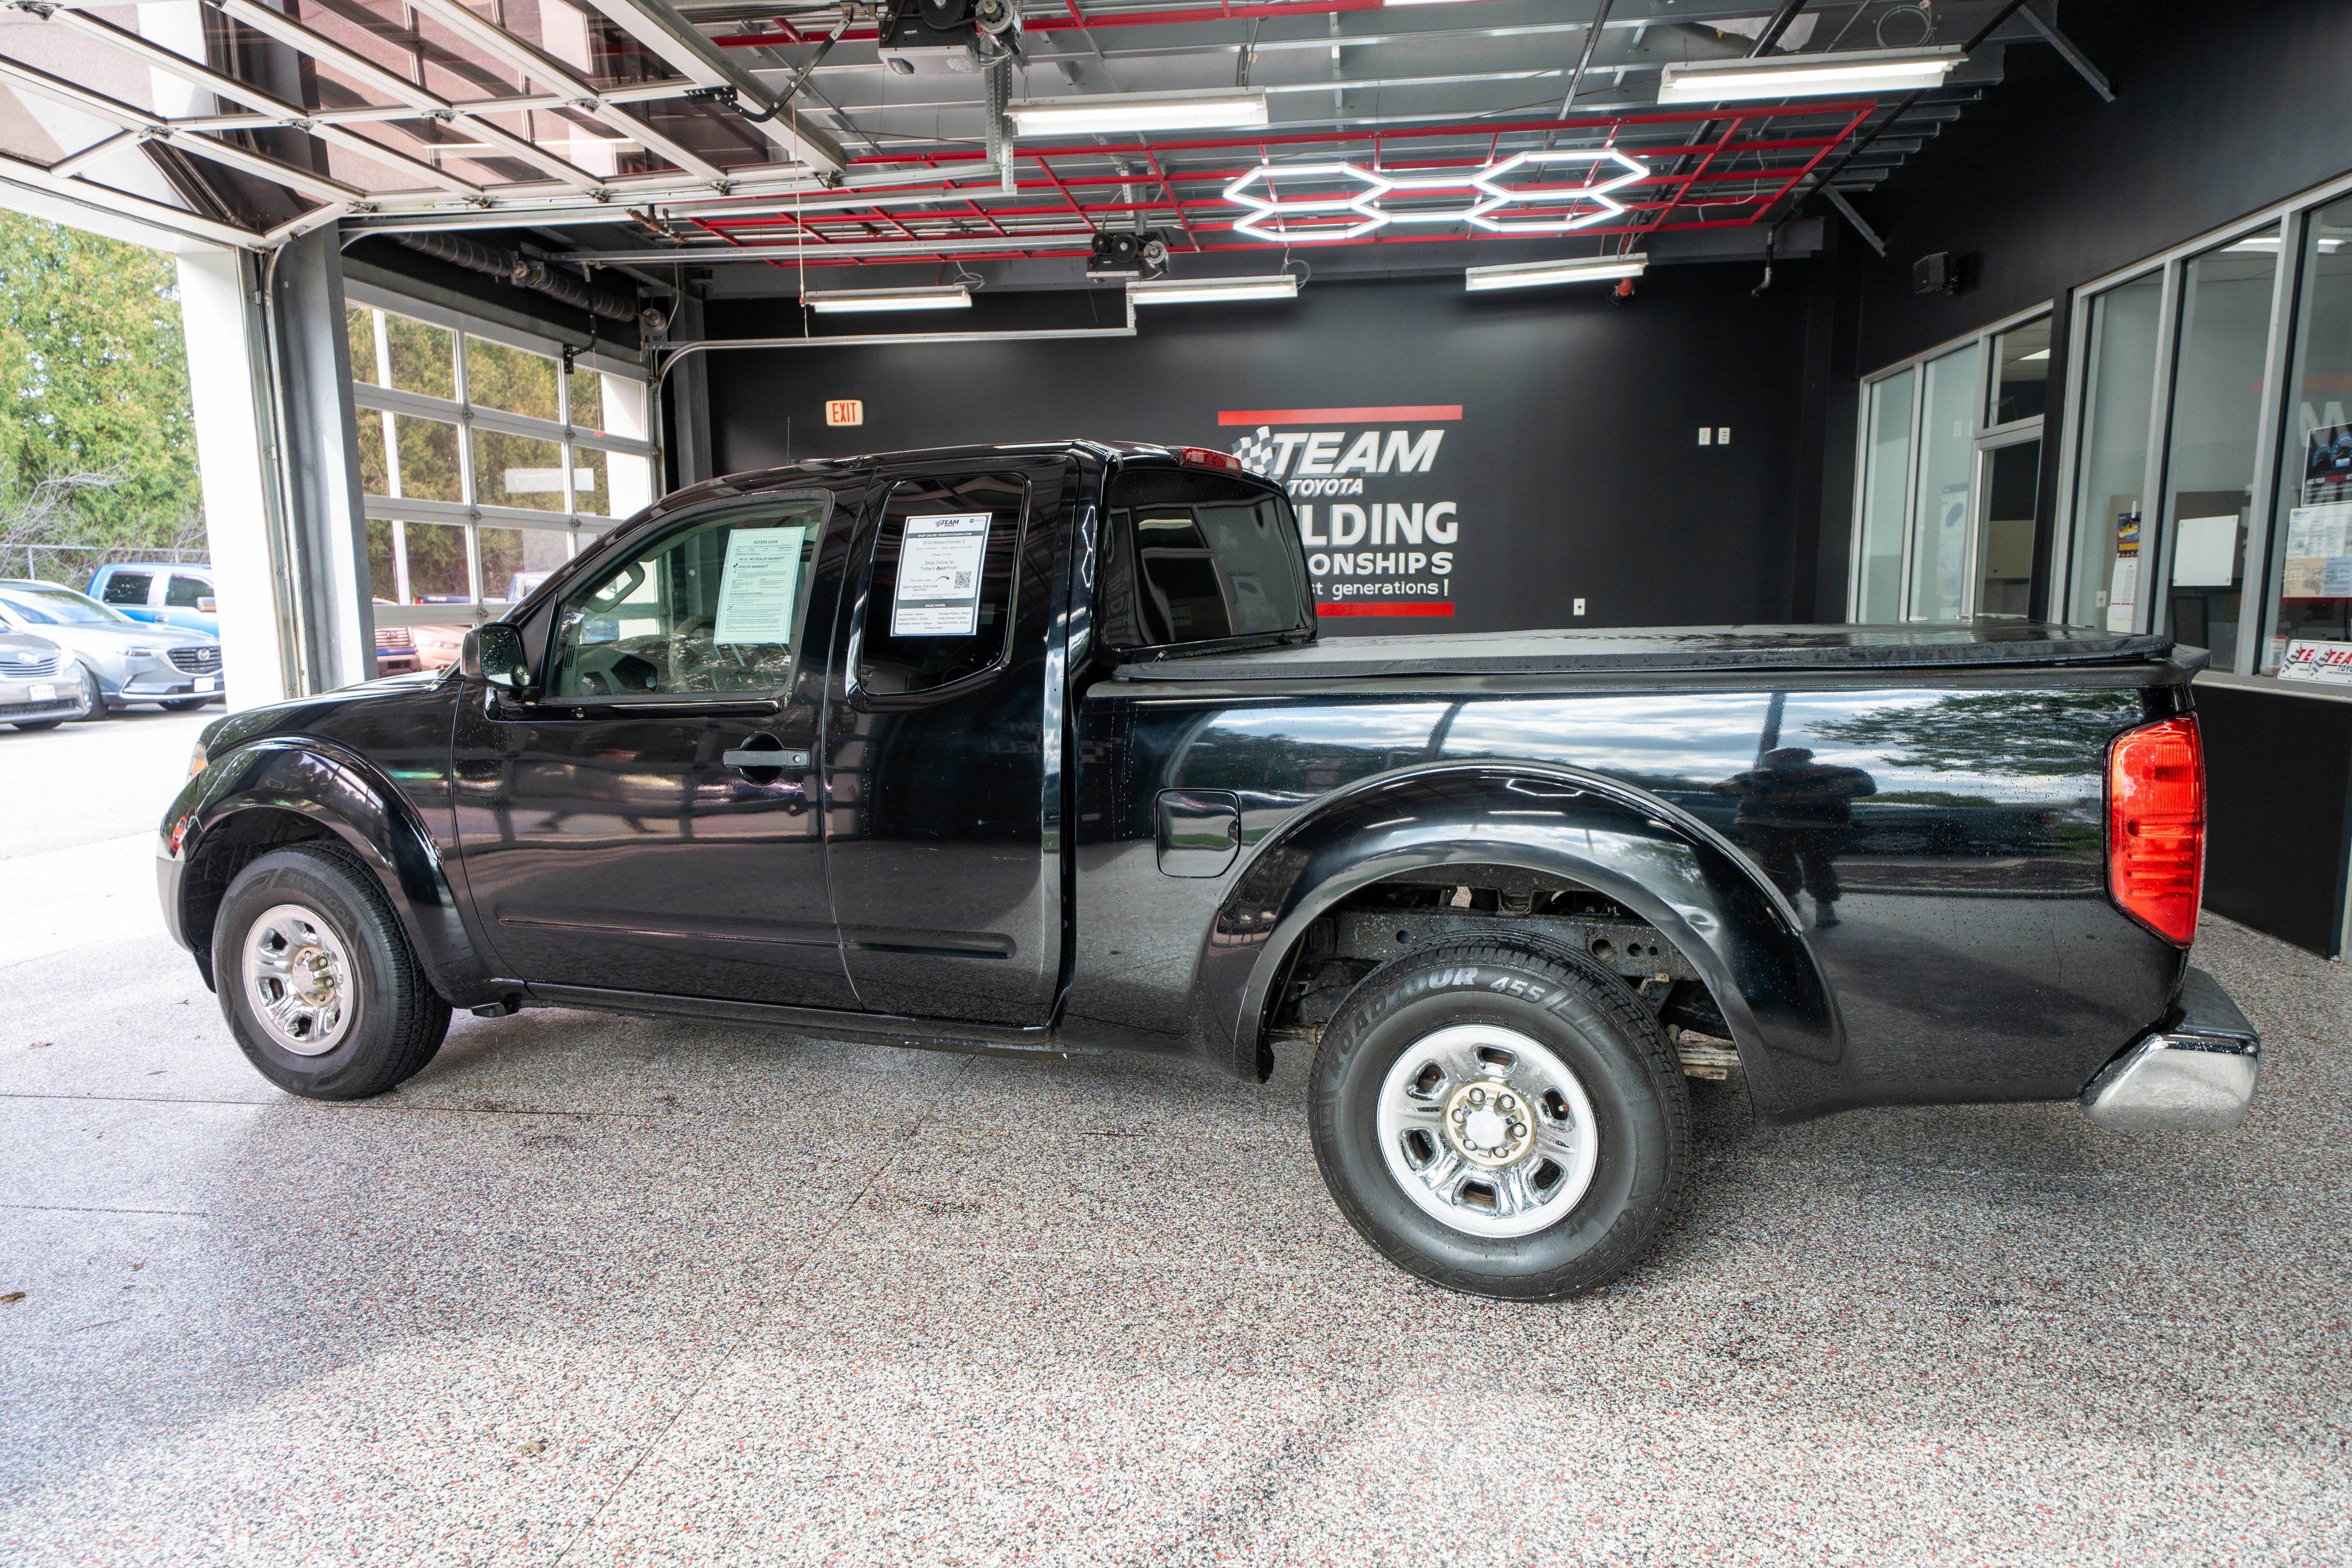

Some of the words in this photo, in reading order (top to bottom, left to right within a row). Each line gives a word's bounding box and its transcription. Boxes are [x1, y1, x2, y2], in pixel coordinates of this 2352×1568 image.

[832, 402, 856, 423] EXIT
[1271, 430, 1445, 476] TEAM
[1287, 479, 1363, 496] TOYOTA
[1292, 501, 1458, 546] LDING
[1489, 976, 1545, 1001] 455
